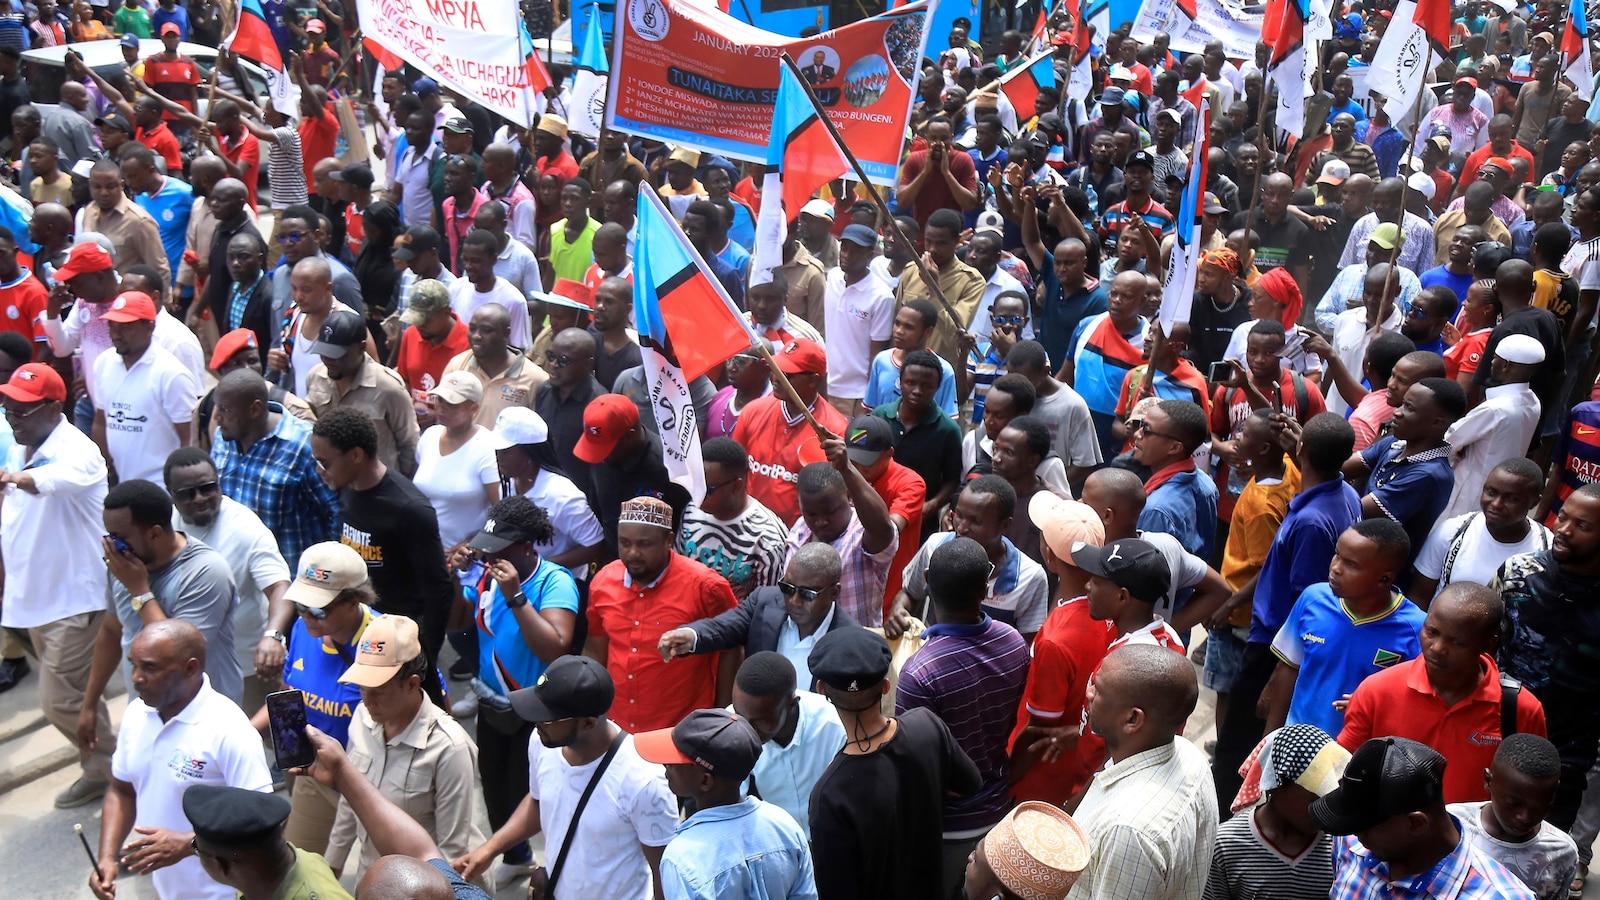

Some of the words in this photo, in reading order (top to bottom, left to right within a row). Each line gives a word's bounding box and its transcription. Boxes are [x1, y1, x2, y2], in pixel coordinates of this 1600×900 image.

[693, 31, 750, 56] JANUARY
[672, 68, 757, 102] TUNAITAKA
[636, 100, 679, 118] IHESHIMU
[681, 112, 715, 124] MAONI
[637, 91, 663, 105] IANZE
[664, 98, 717, 118] MCHAKATO
[675, 91, 718, 110] MISWADA
[850, 111, 893, 124] BUNGENI.
[718, 127, 764, 142] GHARAMA
[748, 454, 799, 484] SportPes
[1572, 456, 1600, 478] QAT
[342, 522, 371, 547] ELEVATE
[301, 690, 353, 718] NZANIA
